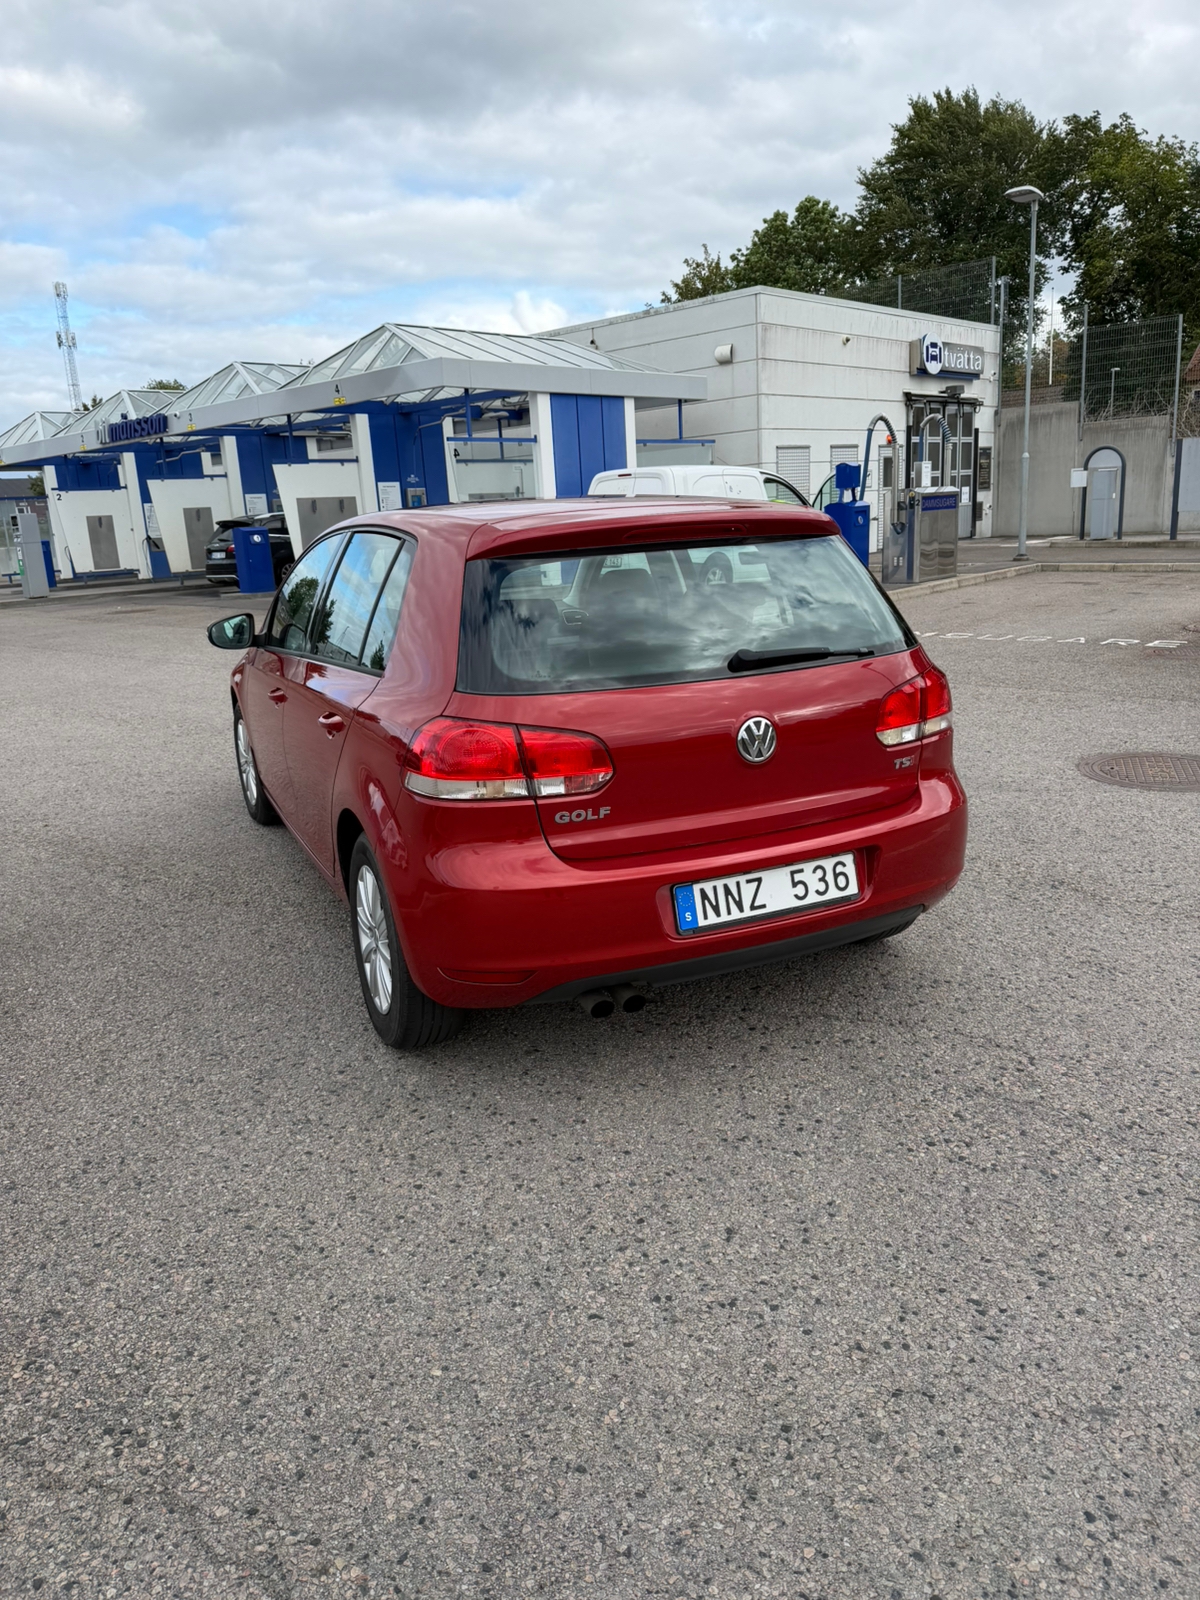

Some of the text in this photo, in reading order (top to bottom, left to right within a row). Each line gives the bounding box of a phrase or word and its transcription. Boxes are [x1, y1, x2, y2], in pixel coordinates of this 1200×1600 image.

[944, 347, 982, 370] tvätta
[335, 384, 340, 395] 4
[56, 493, 62, 501] 2
[922, 497, 956, 509] DAMMSUGARE
[554, 806, 611, 824] GOLF
[699, 860, 850, 920] NNZ 536
[685, 912, 692, 921] S
